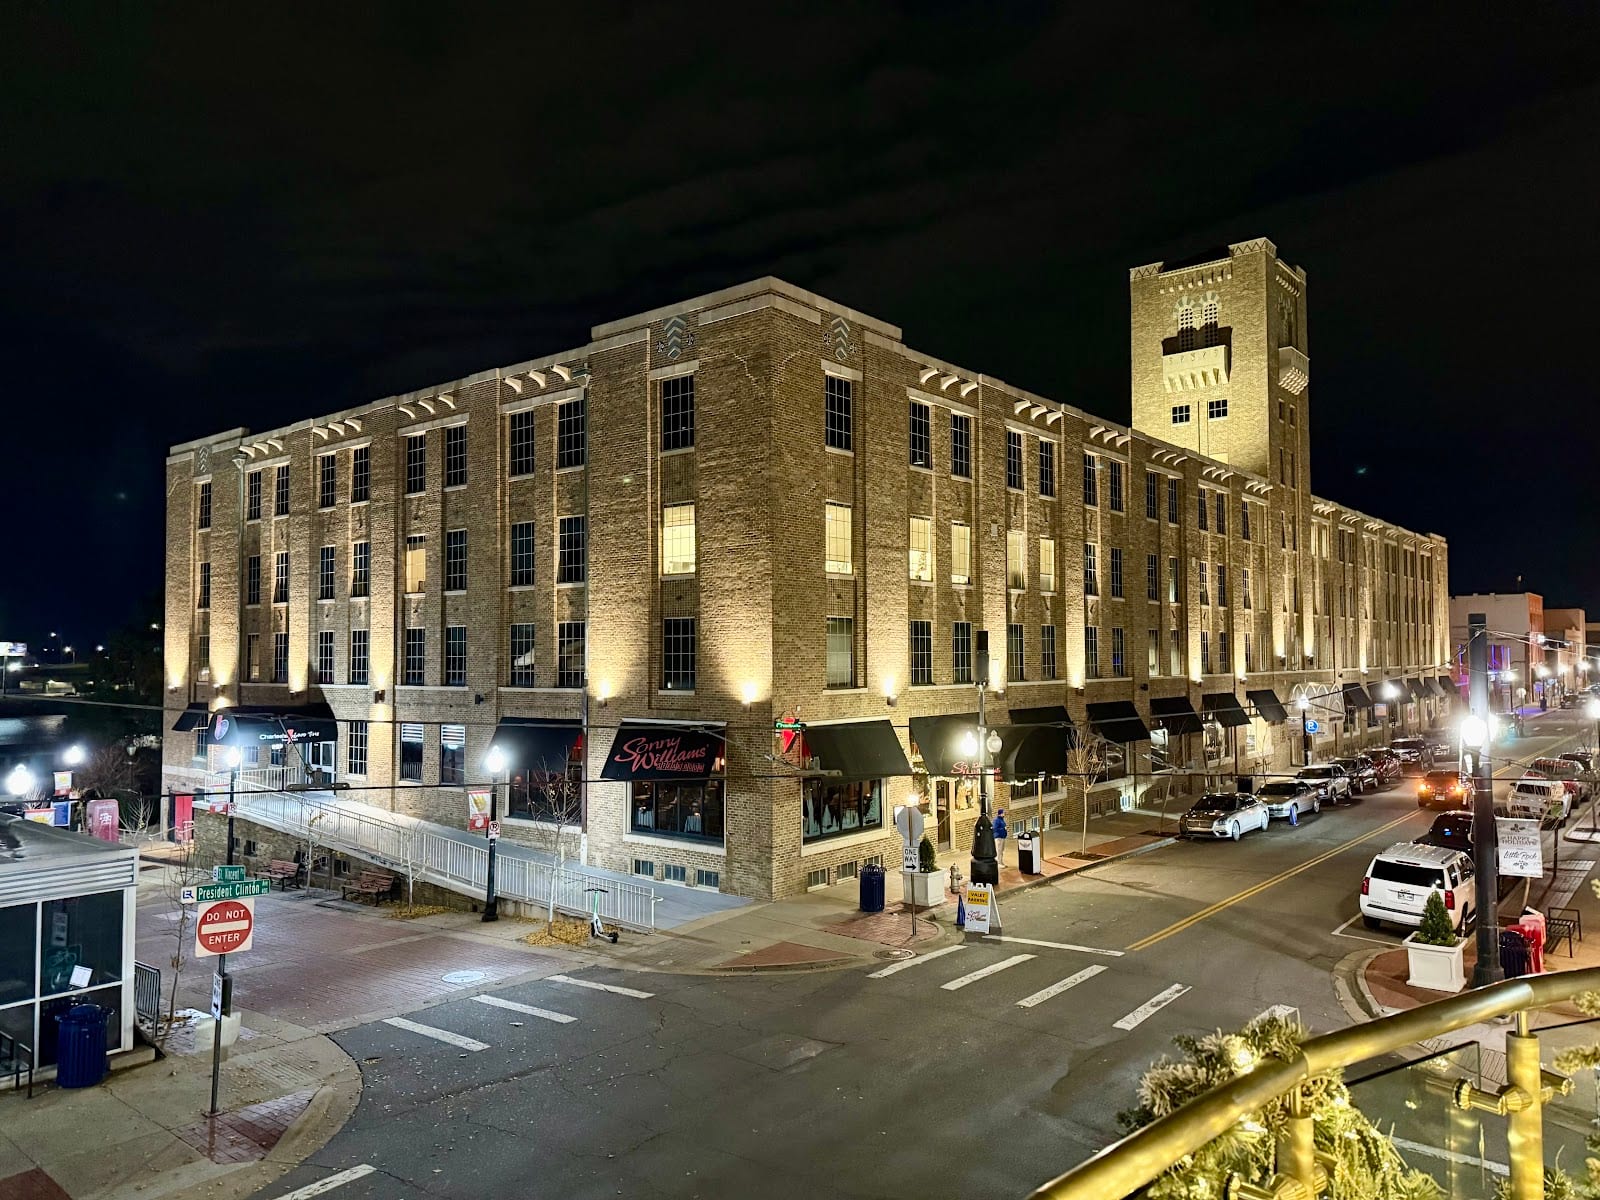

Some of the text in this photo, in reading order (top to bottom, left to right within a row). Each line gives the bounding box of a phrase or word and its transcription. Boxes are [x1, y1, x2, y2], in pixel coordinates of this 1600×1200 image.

[614, 737, 681, 762] Sonny
[904, 848, 917, 856] ONE
[1503, 850, 1538, 860] Little Rock
[904, 856, 918, 864] WAY
[198, 885, 232, 900] President
[235, 881, 260, 896] Clinton
[206, 909, 246, 922] DO NOT
[208, 933, 240, 945] ENTER
